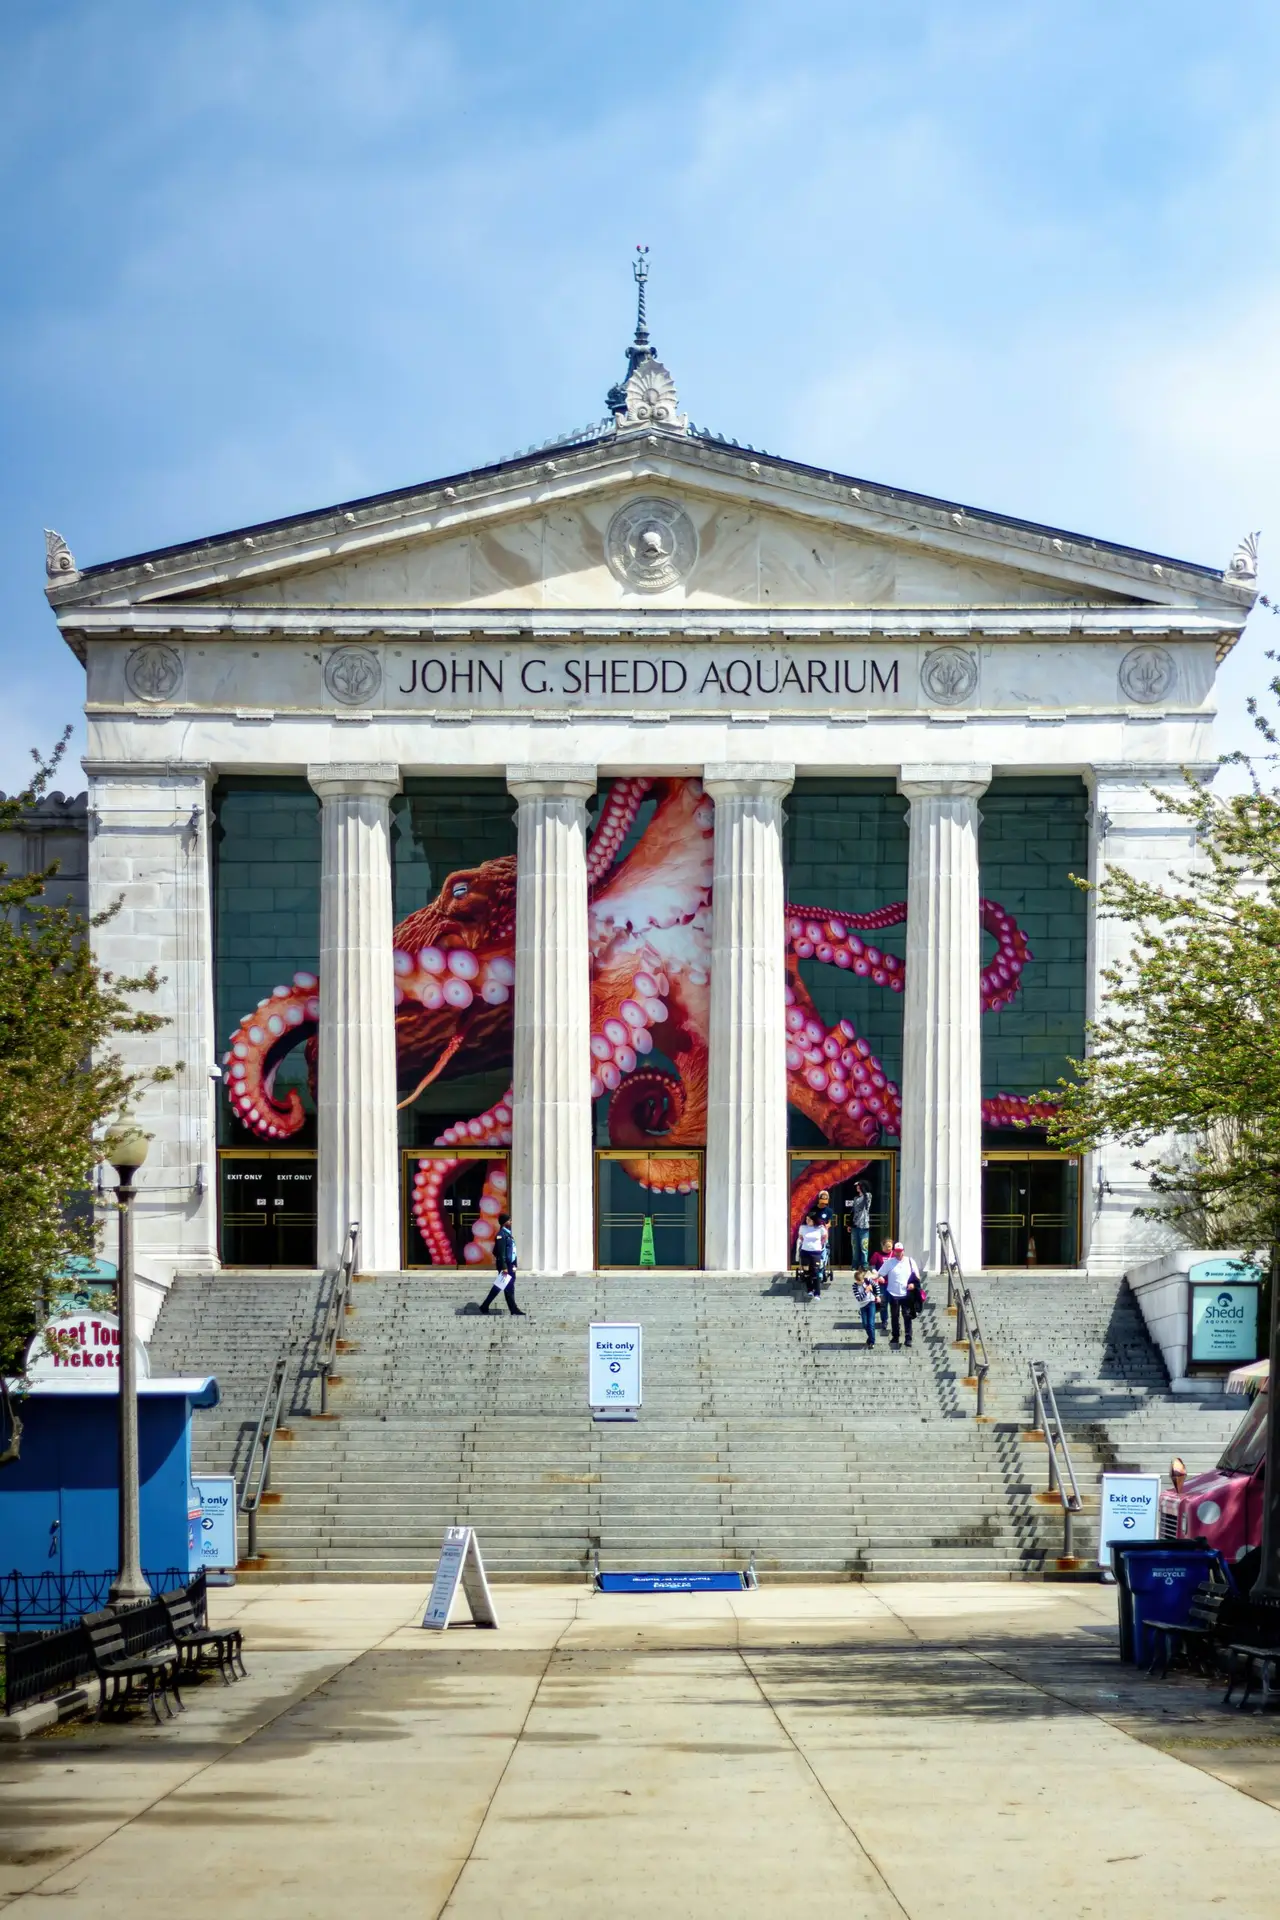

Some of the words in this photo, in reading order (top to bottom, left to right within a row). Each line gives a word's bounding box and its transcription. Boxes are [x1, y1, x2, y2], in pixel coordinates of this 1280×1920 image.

[399, 659, 503, 694] JOHN
[520, 659, 554, 694] G.
[562, 659, 687, 694] SHEDD
[700, 659, 899, 697] AQUARIUM
[1205, 1306, 1244, 1319] Shedd
[46, 1321, 87, 1346] oat
[91, 1321, 121, 1346] Tou
[596, 1341, 613, 1350] Exit
[615, 1341, 635, 1351] only
[207, 1496, 228, 1506] only
[1110, 1494, 1128, 1502] Exit
[1130, 1495, 1152, 1505] only
